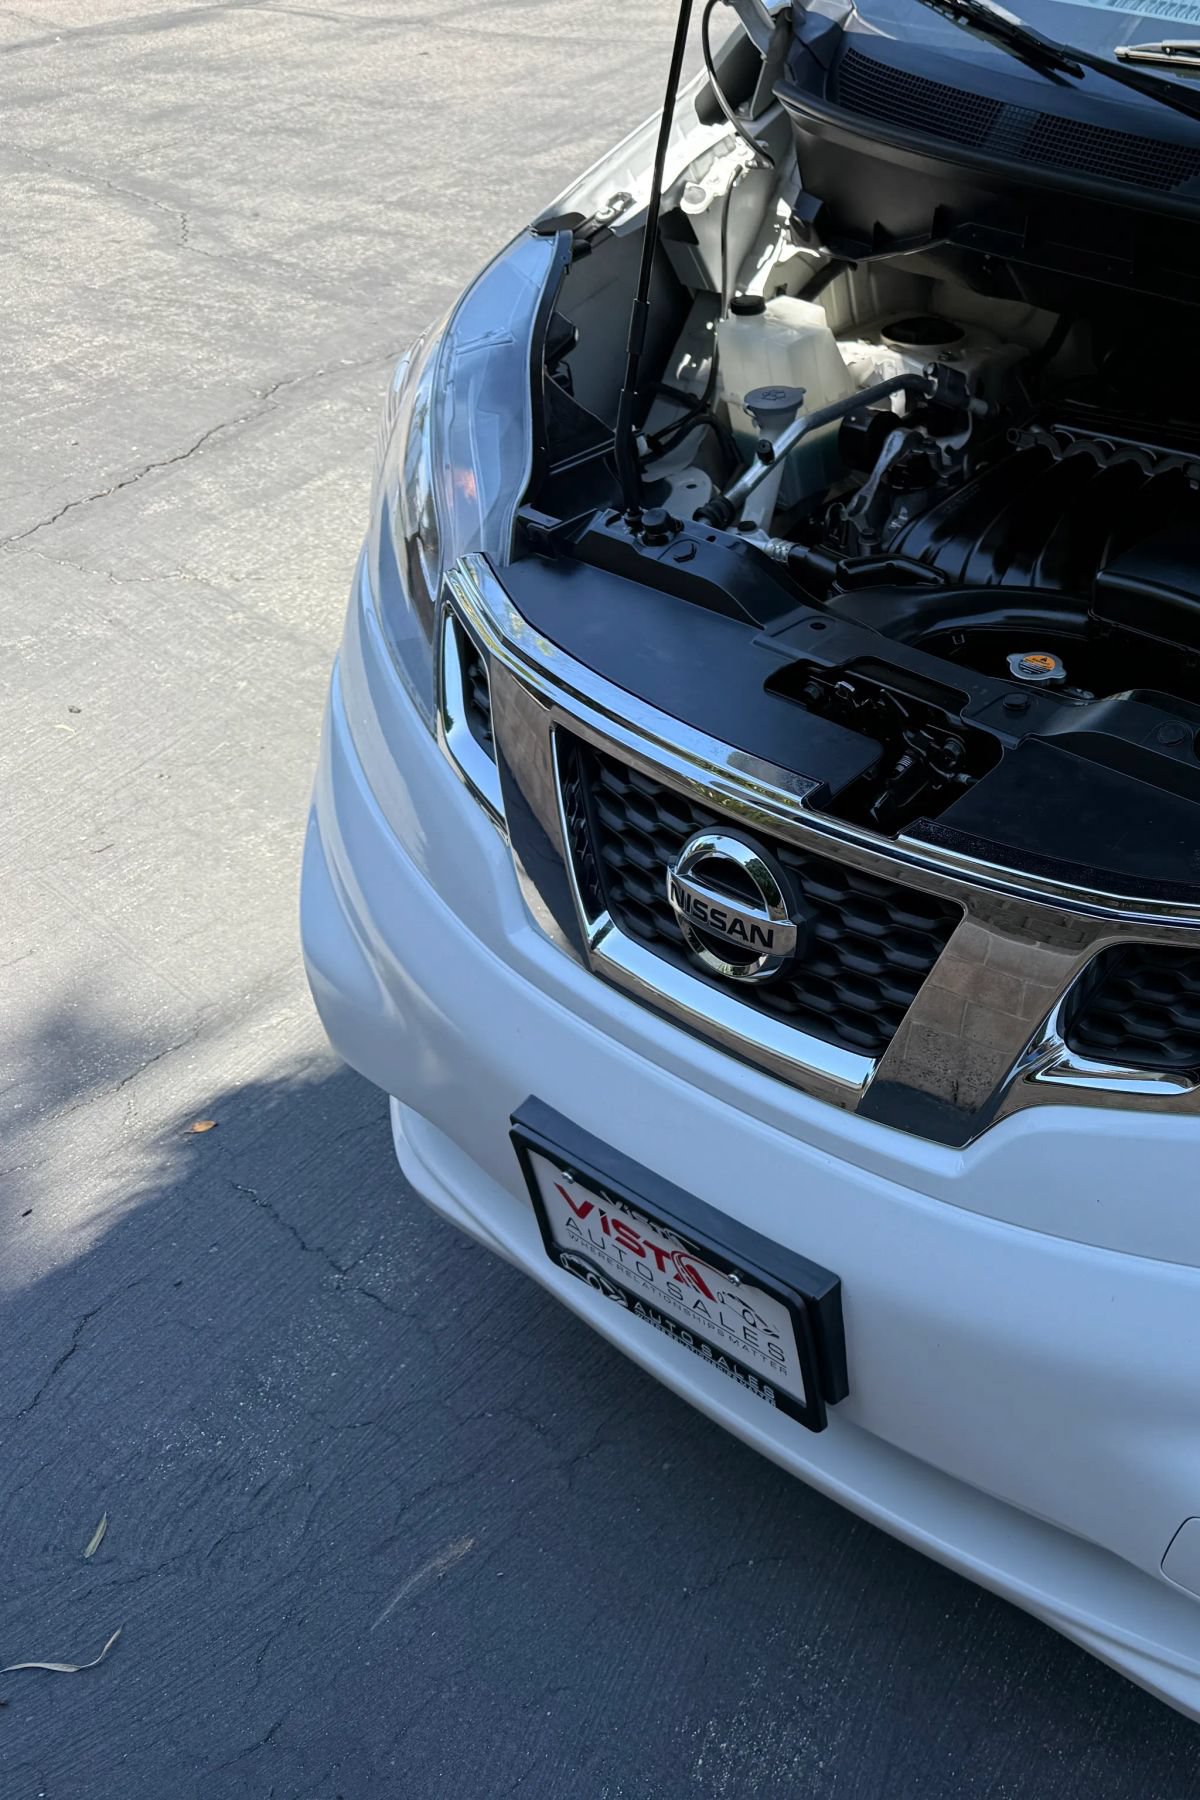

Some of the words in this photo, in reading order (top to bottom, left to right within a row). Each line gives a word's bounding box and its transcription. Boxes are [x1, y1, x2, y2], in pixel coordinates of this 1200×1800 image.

[671, 880, 774, 949] NISSAN
[554, 1182, 718, 1303] VISTA
[566, 1217, 654, 1282] AUTO
[666, 1281, 785, 1362] SALES
[568, 1231, 613, 1265] WHERE
[616, 1263, 725, 1337] RELATIONSHIPS
[729, 1335, 788, 1376] MATTER
[634, 1302, 694, 1345] AUTO
[701, 1343, 775, 1399] SALES
